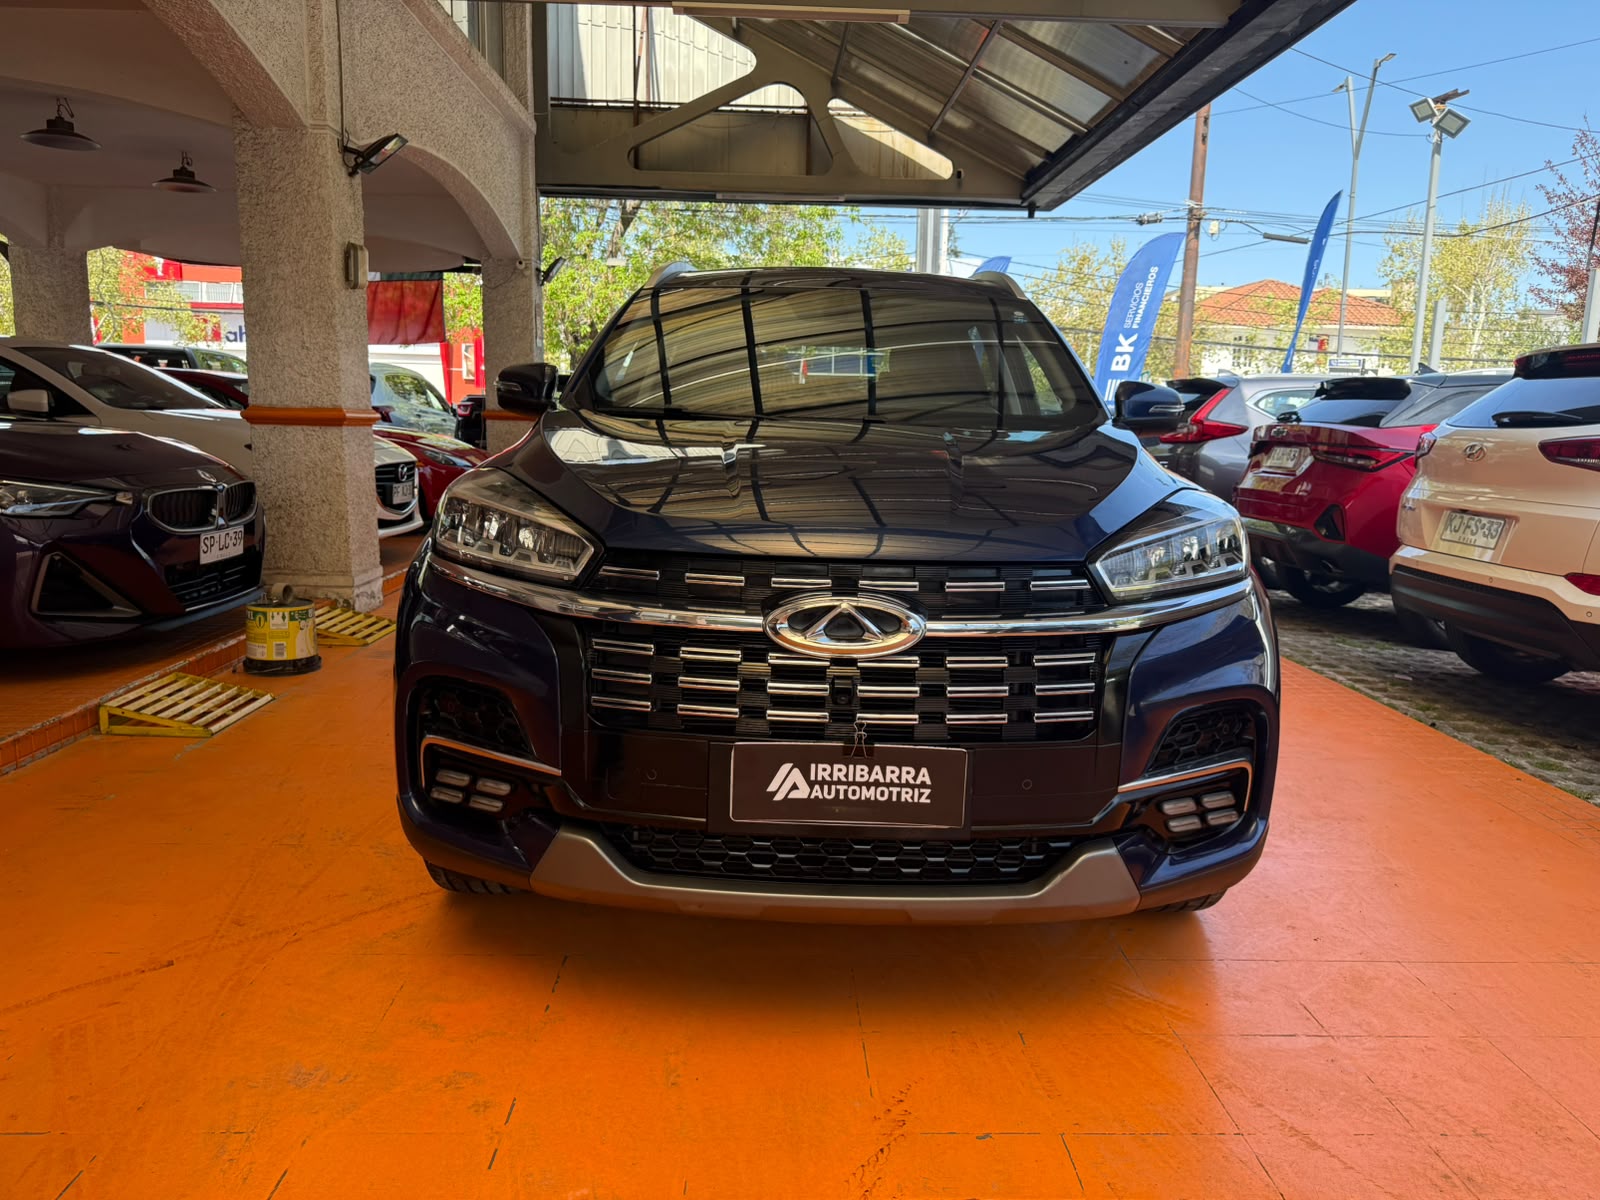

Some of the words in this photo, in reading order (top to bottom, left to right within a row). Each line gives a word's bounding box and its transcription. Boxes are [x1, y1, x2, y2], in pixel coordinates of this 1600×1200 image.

[1123, 282, 1144, 328] SERVICIOS
[1131, 266, 1159, 329] FINANCIEROS
[1110, 333, 1138, 371] BK
[810, 763, 932, 785] IRRIBARRA
[810, 784, 932, 804] AUTOMOTRIZ
